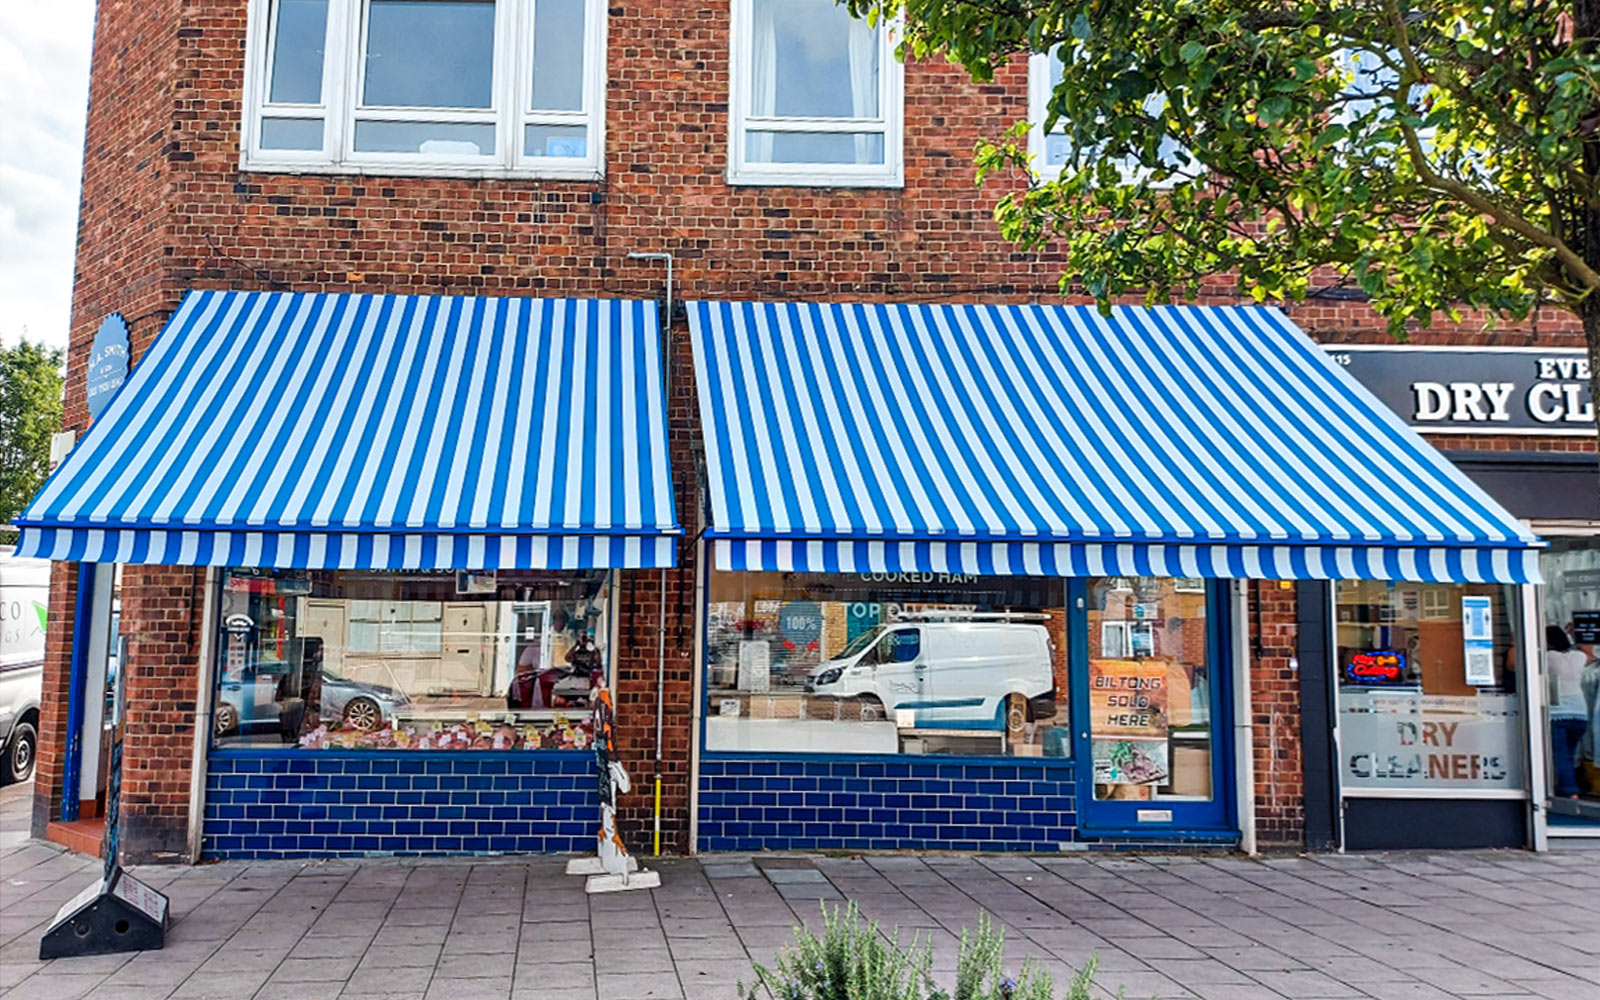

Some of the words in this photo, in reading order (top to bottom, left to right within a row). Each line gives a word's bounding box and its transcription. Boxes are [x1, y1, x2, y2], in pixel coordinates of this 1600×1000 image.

[1413, 382, 1514, 421] DRY
[861, 571, 934, 583] COOKED
[939, 572, 978, 584] HAM
[786, 615, 818, 631] 100%
[1094, 676, 1162, 690] BILTONG
[1107, 695, 1150, 709] SOLD
[1107, 714, 1149, 728] HERE
[1397, 721, 1459, 747] DRY
[1349, 753, 1507, 780] CLEANERS
